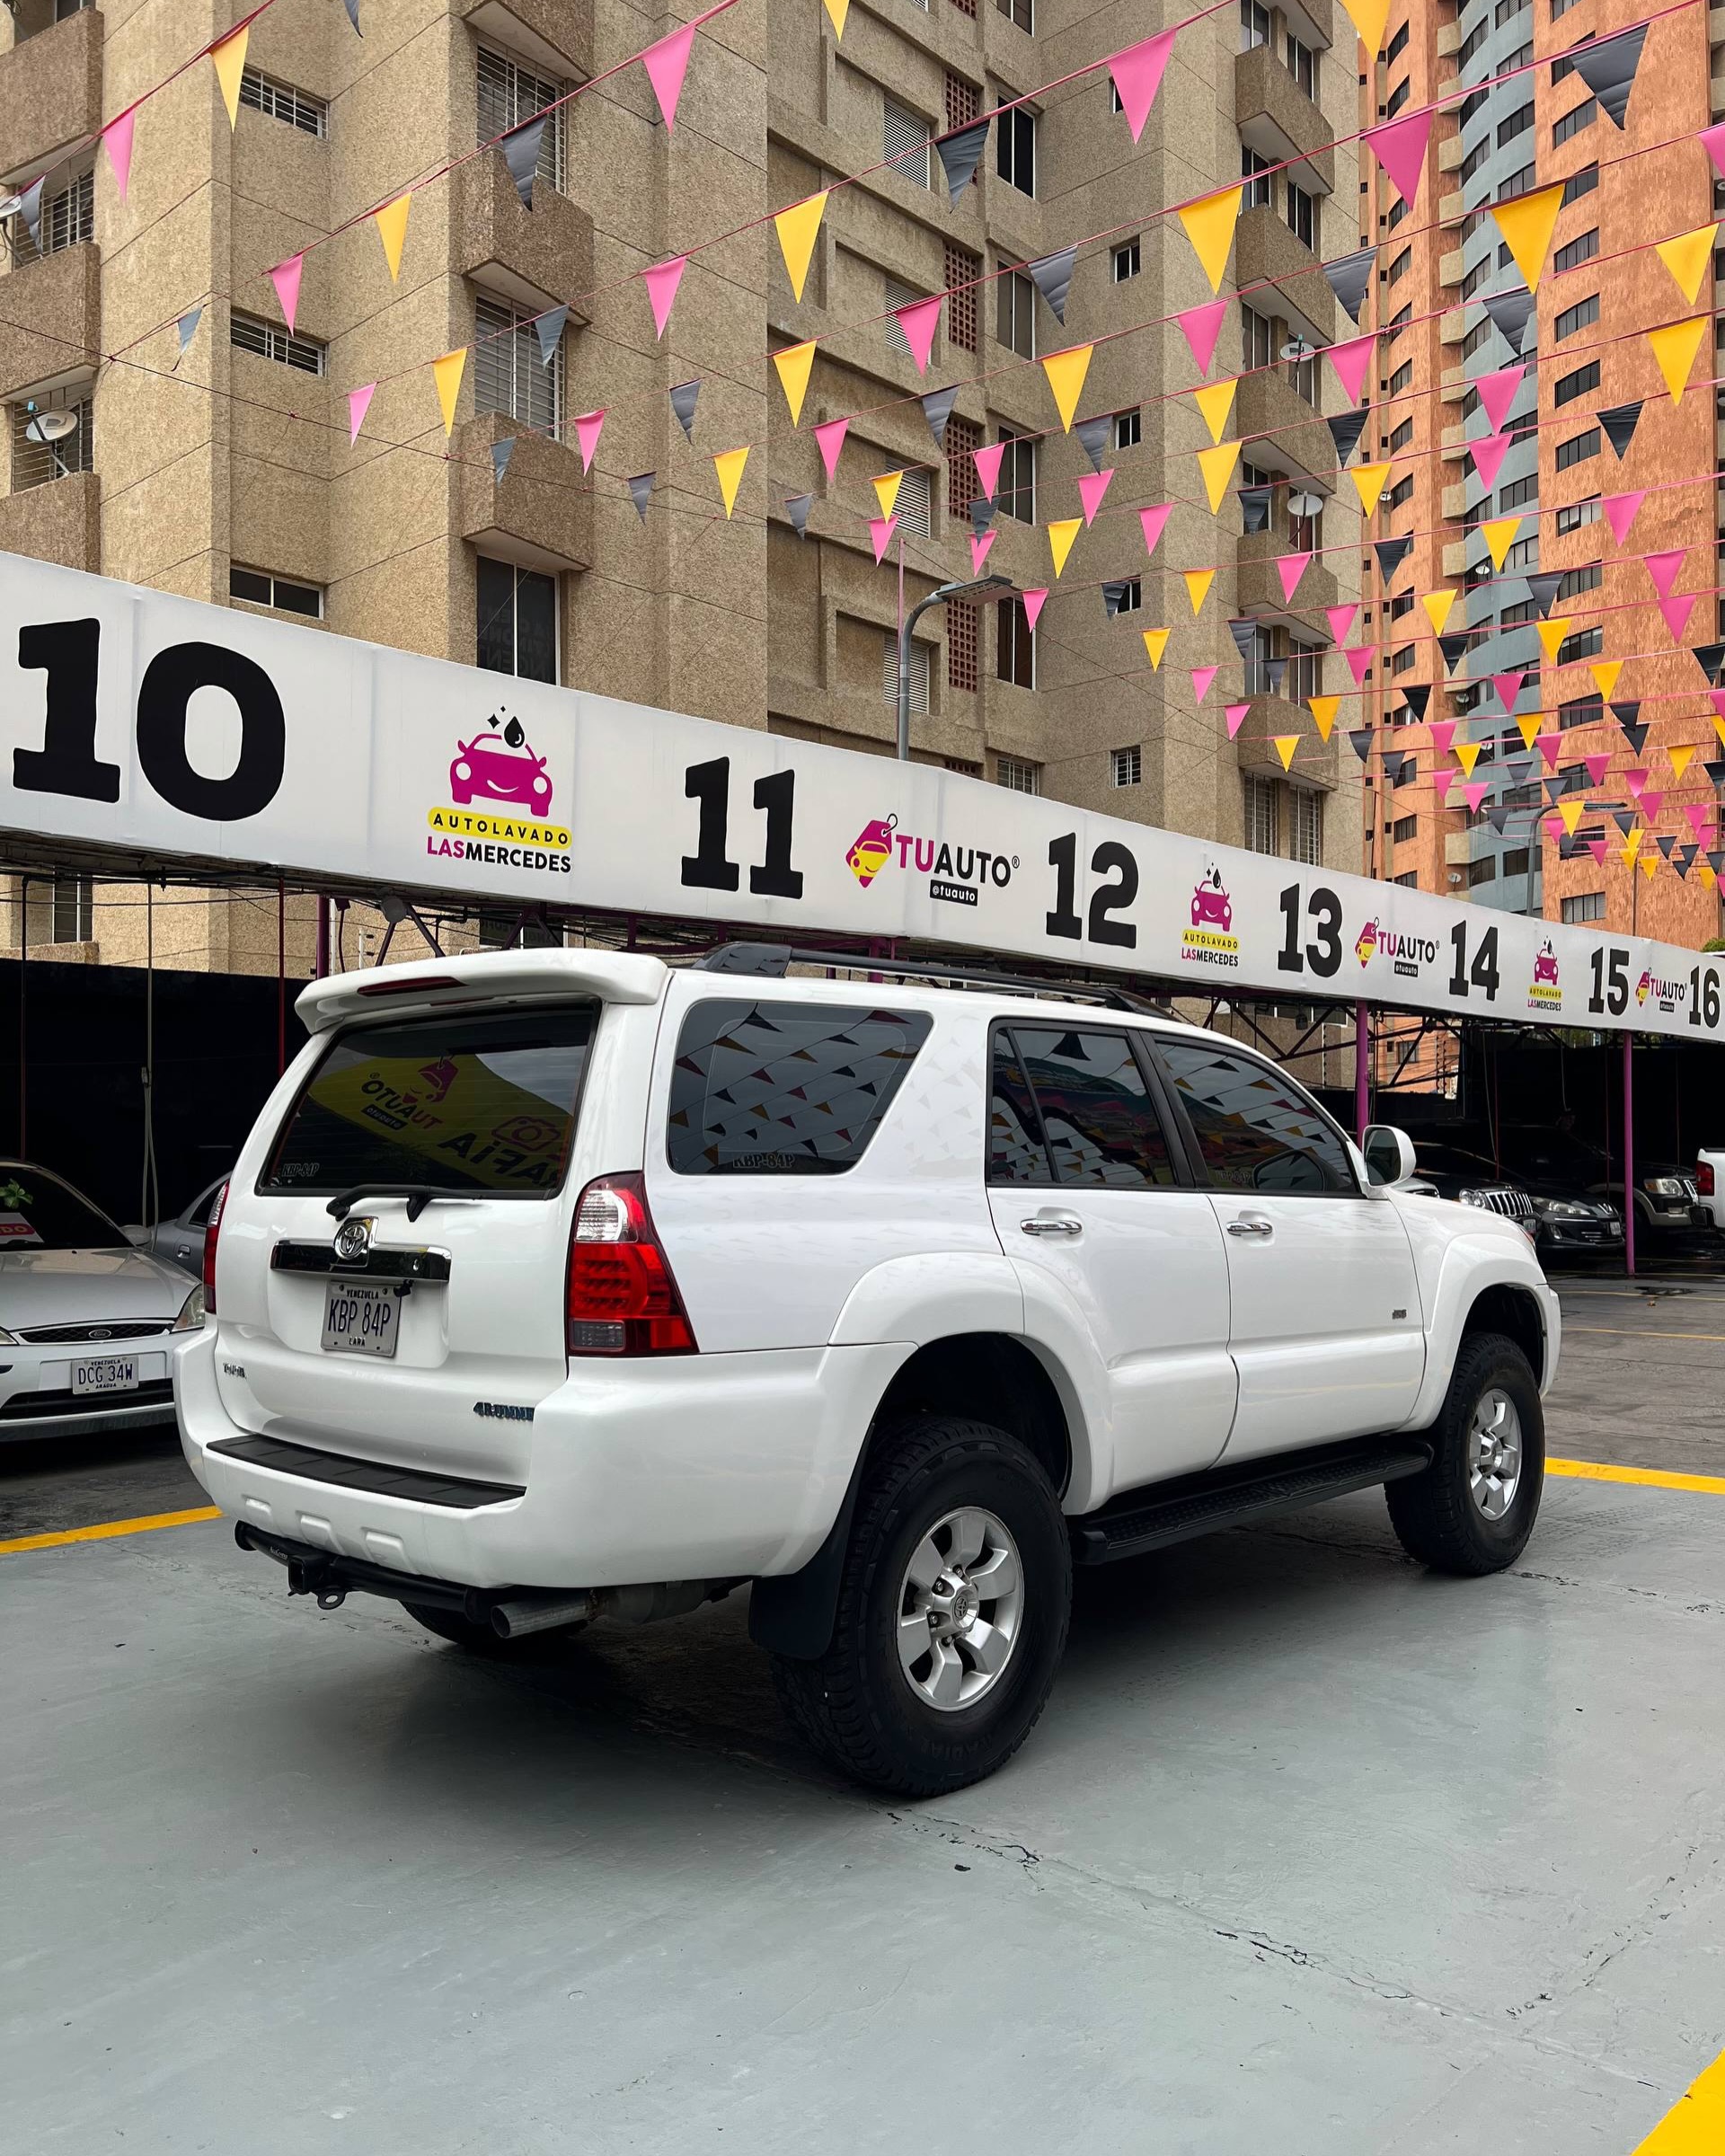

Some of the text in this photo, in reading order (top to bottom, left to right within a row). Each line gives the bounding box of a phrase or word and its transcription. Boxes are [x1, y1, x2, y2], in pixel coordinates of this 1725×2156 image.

[13, 617, 286, 822] 10
[433, 813, 569, 845] AUTOLAVADO
[681, 756, 803, 900] 11
[932, 885, 976, 902] @tuauto
[1046, 832, 1139, 950] 12
[1184, 932, 1238, 949] AUTOLAVADO
[1278, 882, 1343, 978] 13
[1449, 920, 1499, 1002] 14
[1588, 946, 1630, 1016] 15
[1689, 965, 1721, 1029] 16
[328, 1299, 391, 1337] KBP 84P
[347, 1289, 379, 1300] VENEZUELA
[349, 1337, 366, 1347] LARA
[78, 1363, 133, 1385] DCG 34W
